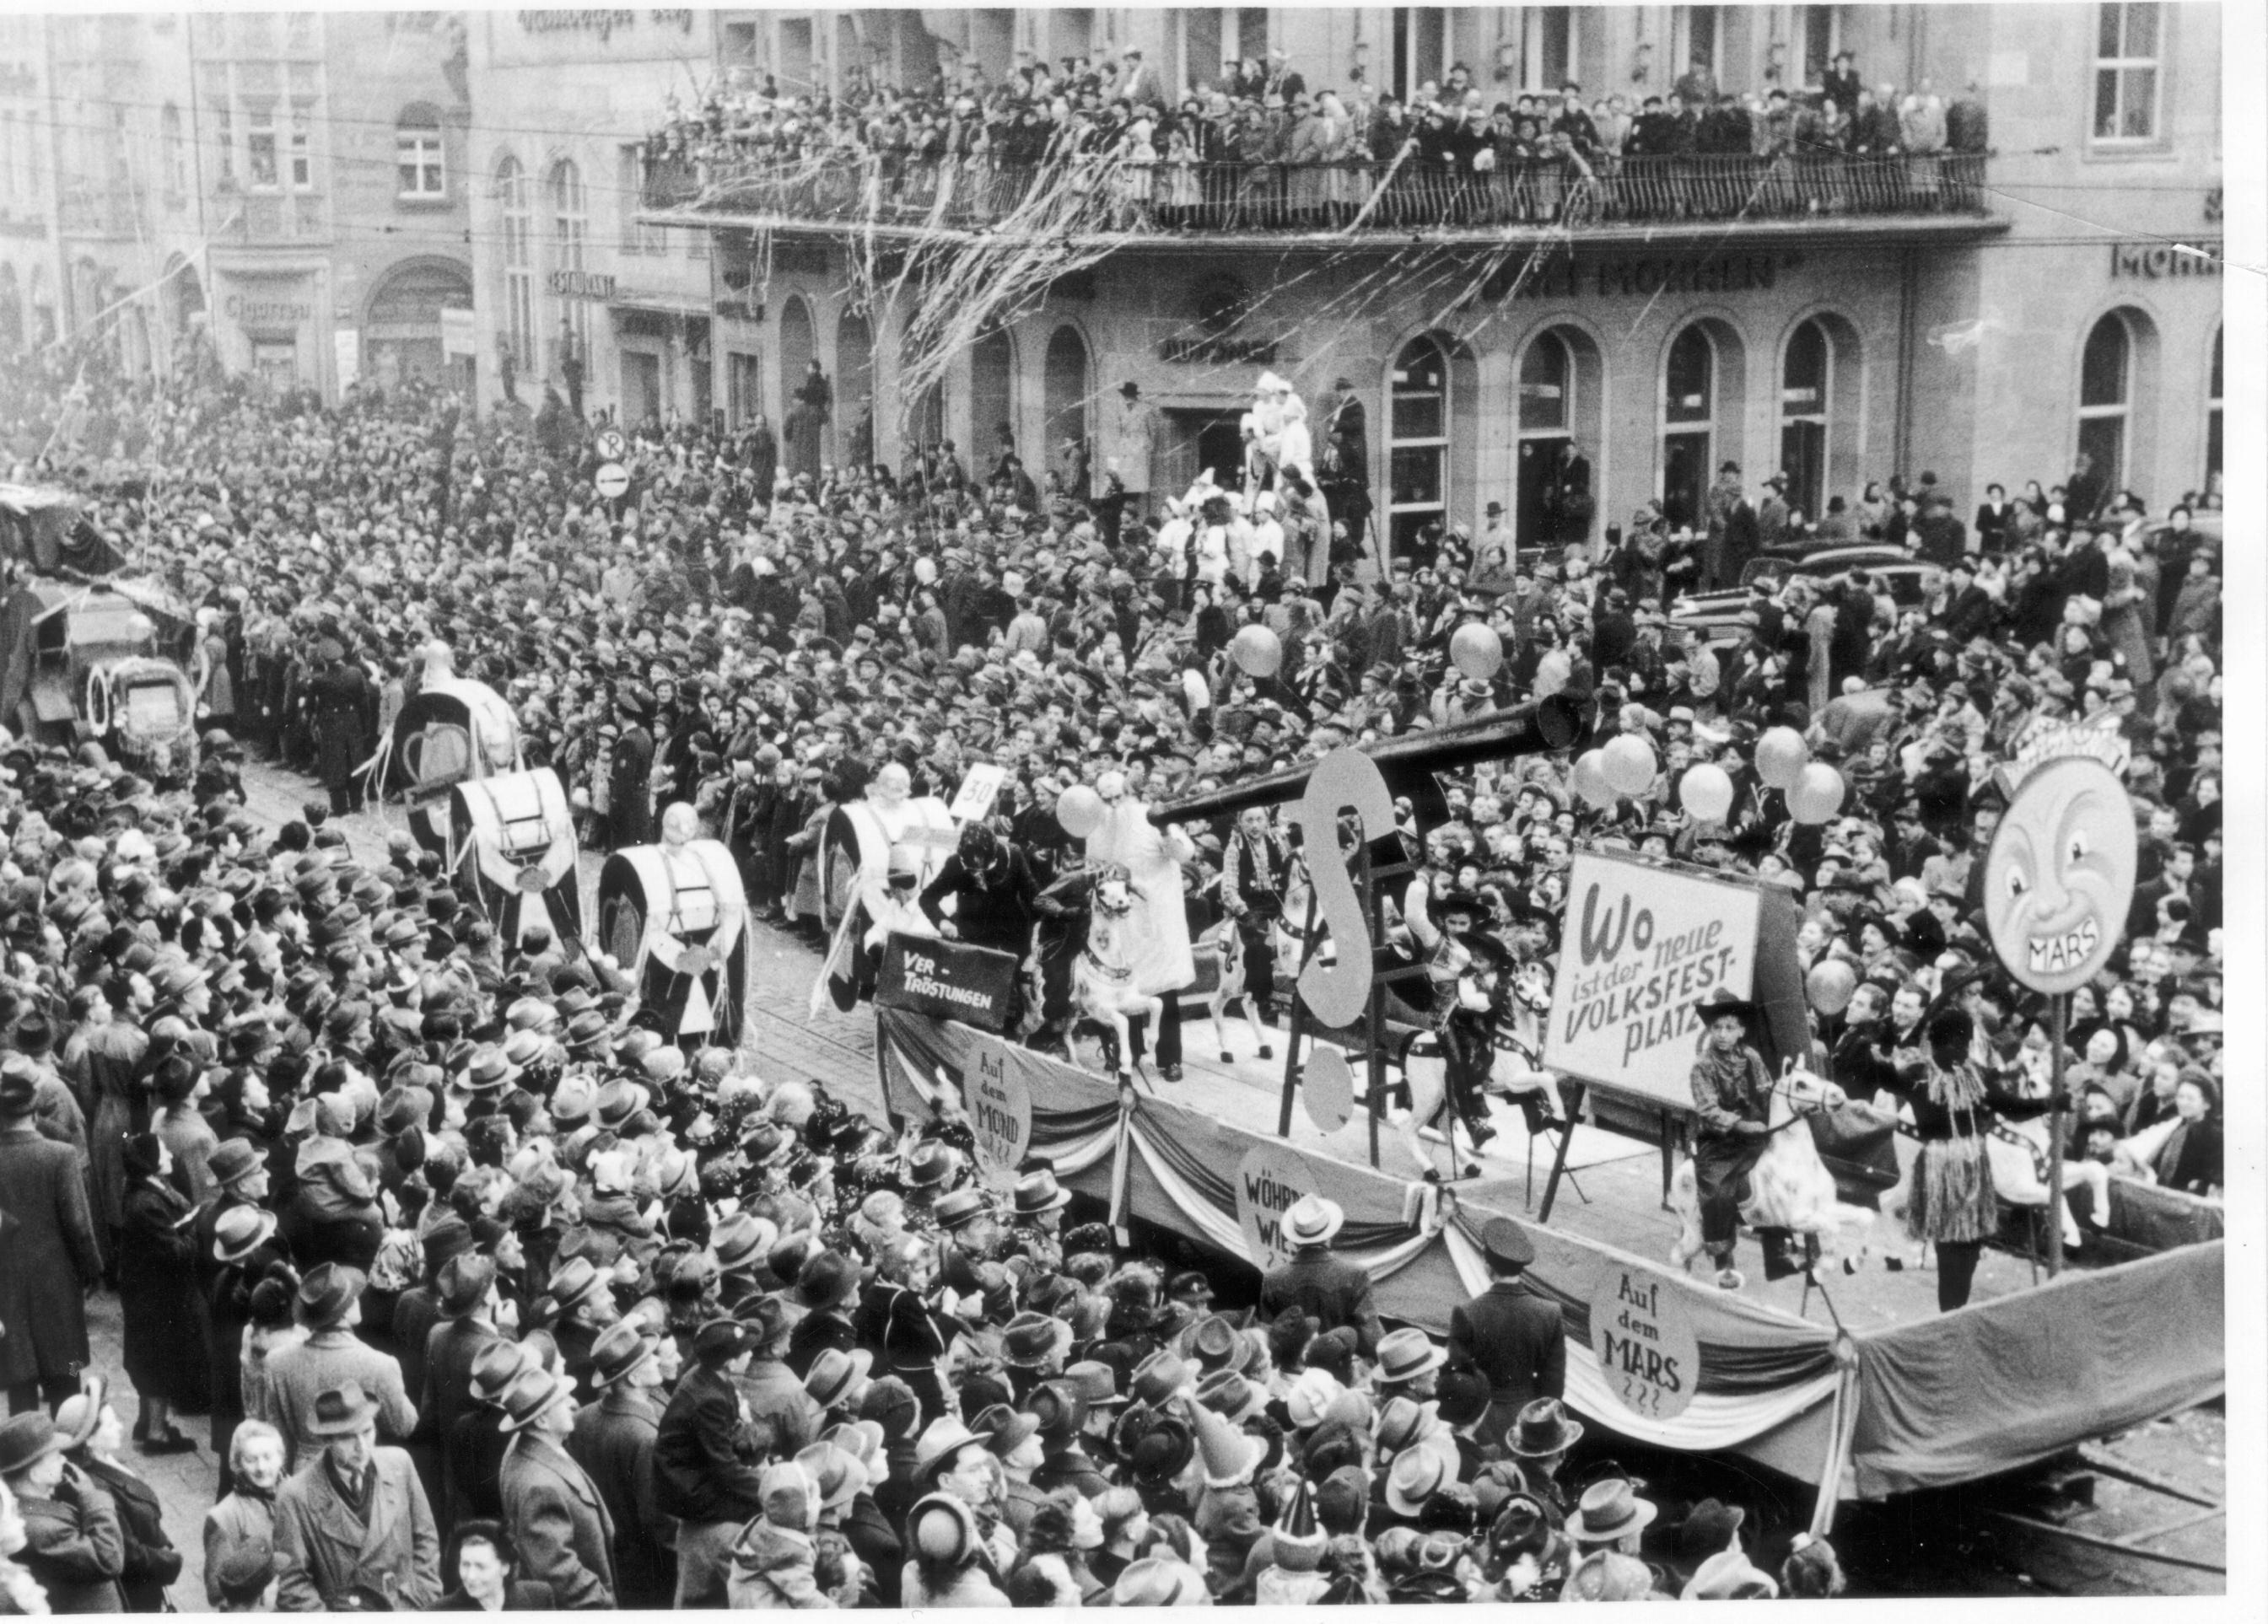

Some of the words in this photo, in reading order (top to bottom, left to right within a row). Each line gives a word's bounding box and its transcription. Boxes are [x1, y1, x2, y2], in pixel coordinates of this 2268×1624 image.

[1581, 883, 1655, 966] Wo
[2029, 920, 2096, 971] MARS
[1604, 961, 1643, 992] der
[1654, 920, 1723, 971] neue
[904, 971, 993, 1009] TRÖSTUNGEN
[979, 1051, 1004, 1084] Auf
[981, 1079, 1007, 1103] dem
[976, 1100, 1019, 1144] MOND
[1244, 1168, 1305, 1213] WÖHRD
[1618, 1273, 1659, 1319] Auf
[1618, 1309, 1659, 1342] dem
[1603, 1328, 1681, 1393] MARS
